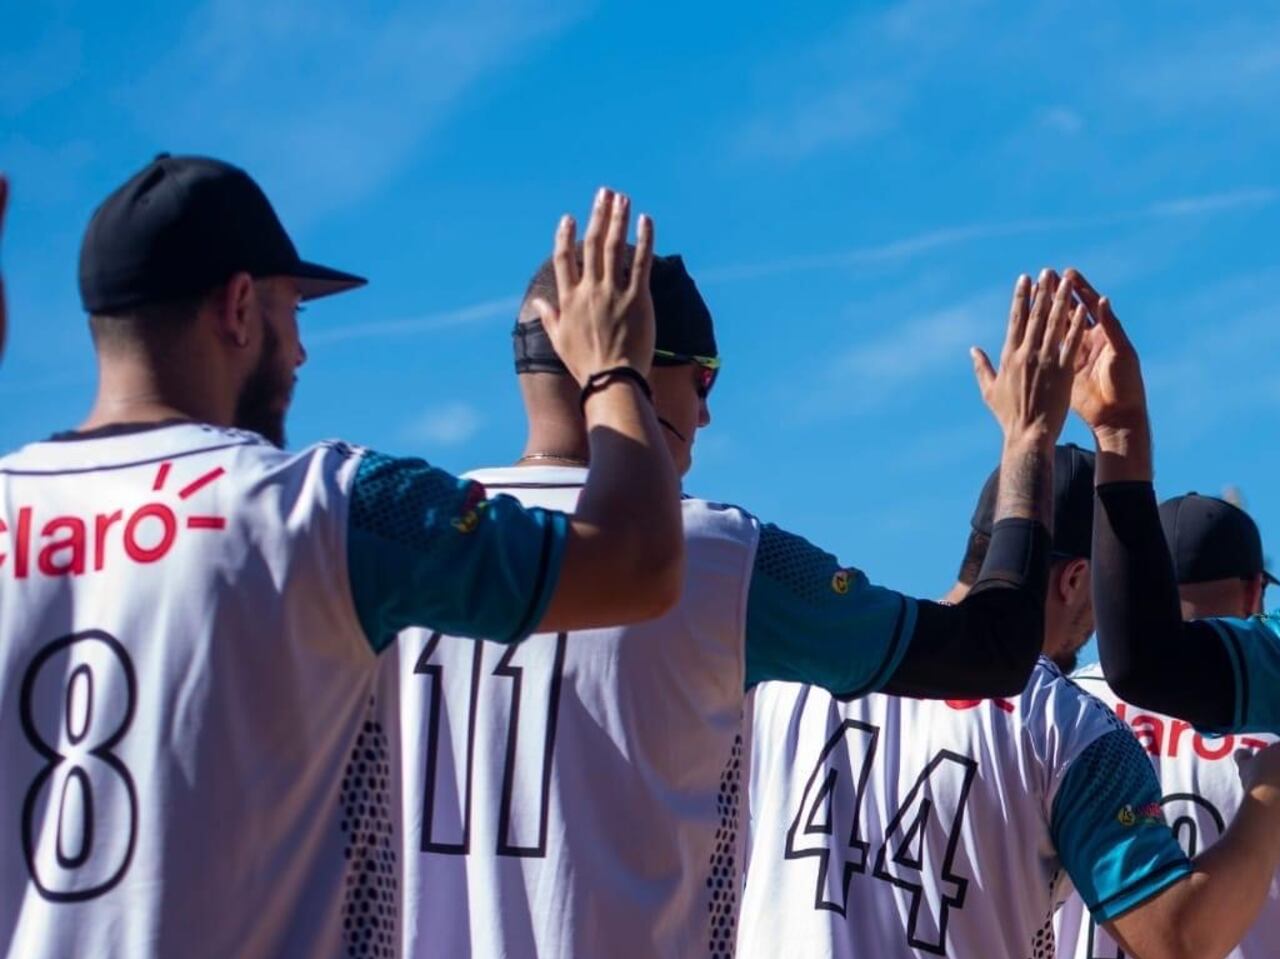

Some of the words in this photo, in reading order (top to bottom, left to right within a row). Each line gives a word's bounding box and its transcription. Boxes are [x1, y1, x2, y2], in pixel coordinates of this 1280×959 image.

[0, 503, 177, 580] laro
[19, 628, 137, 902] 8
[413, 633, 567, 858] 11
[784, 718, 978, 956] 44
